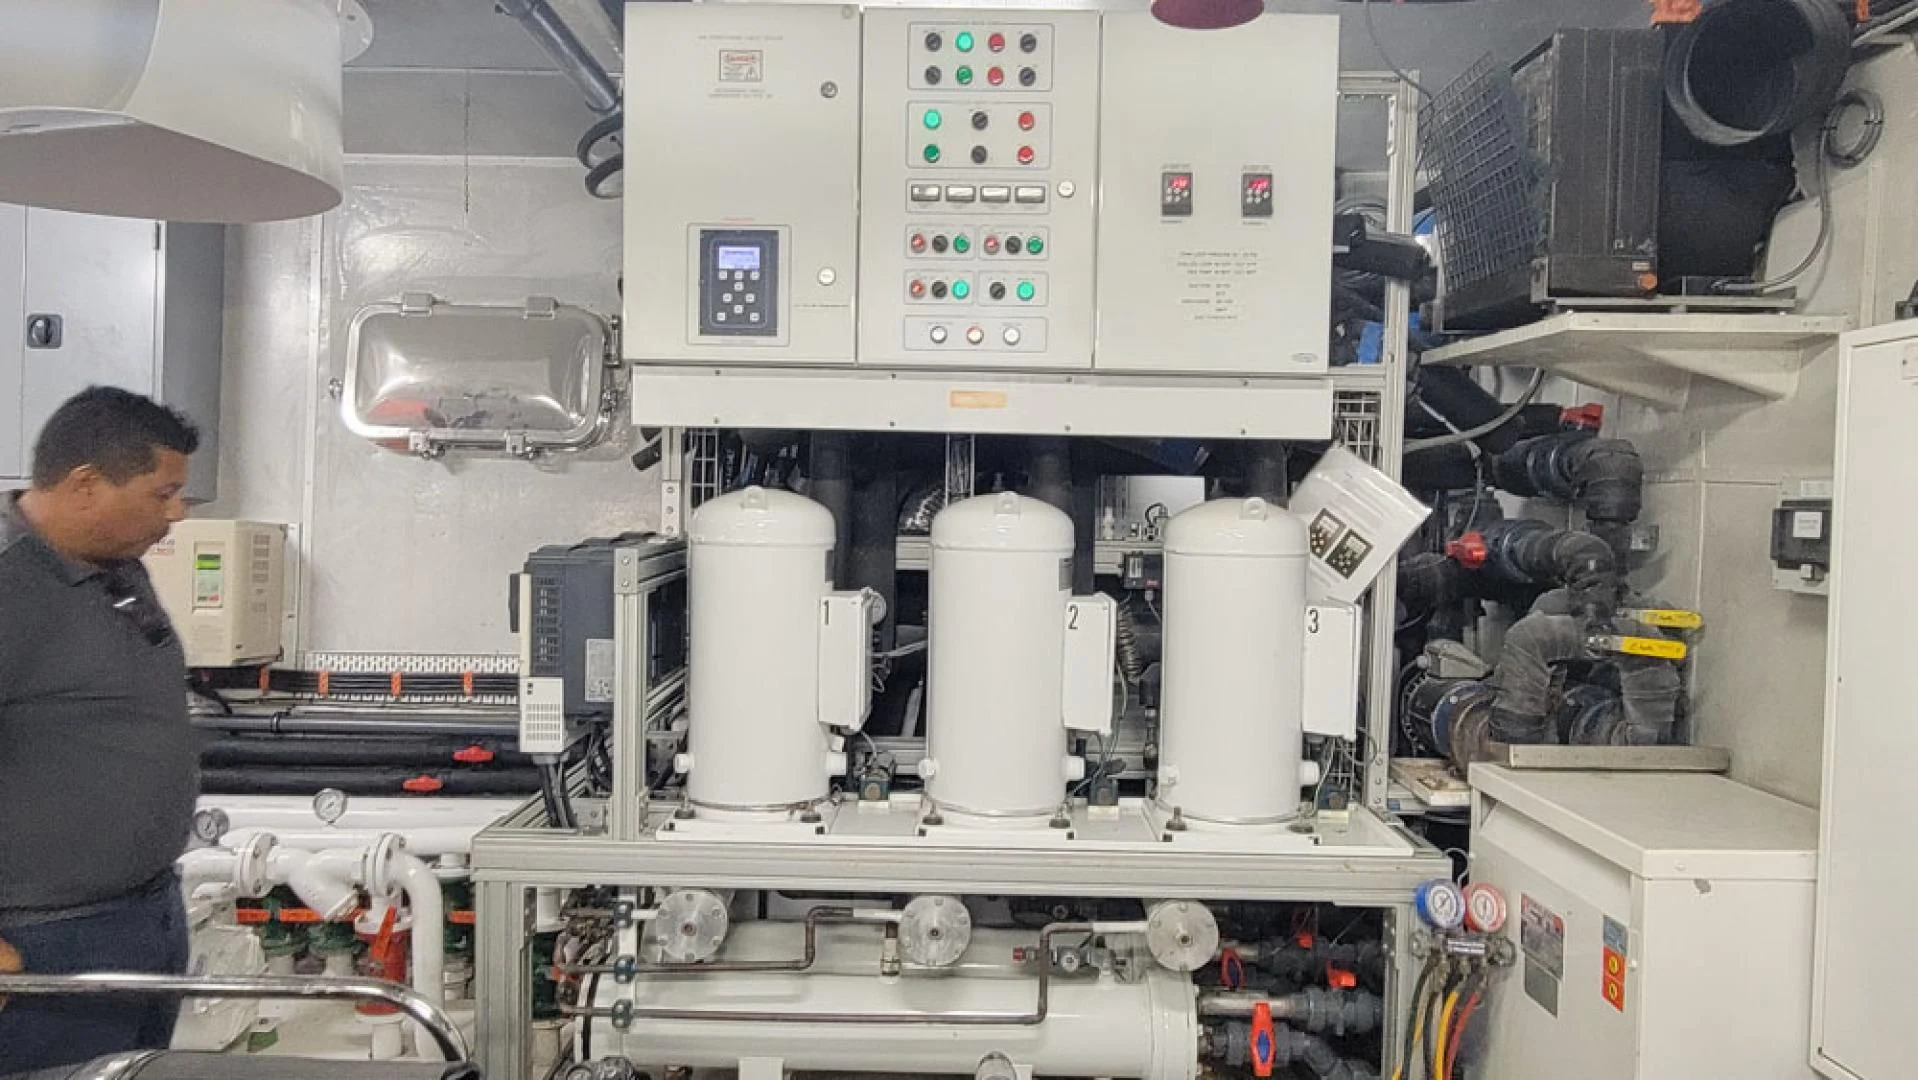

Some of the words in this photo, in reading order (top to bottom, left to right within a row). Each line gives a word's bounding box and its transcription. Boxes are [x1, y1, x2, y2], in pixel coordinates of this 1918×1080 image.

[823, 600, 830, 626] 1
[1068, 604, 1078, 629] 2
[1308, 608, 1318, 633] 3
